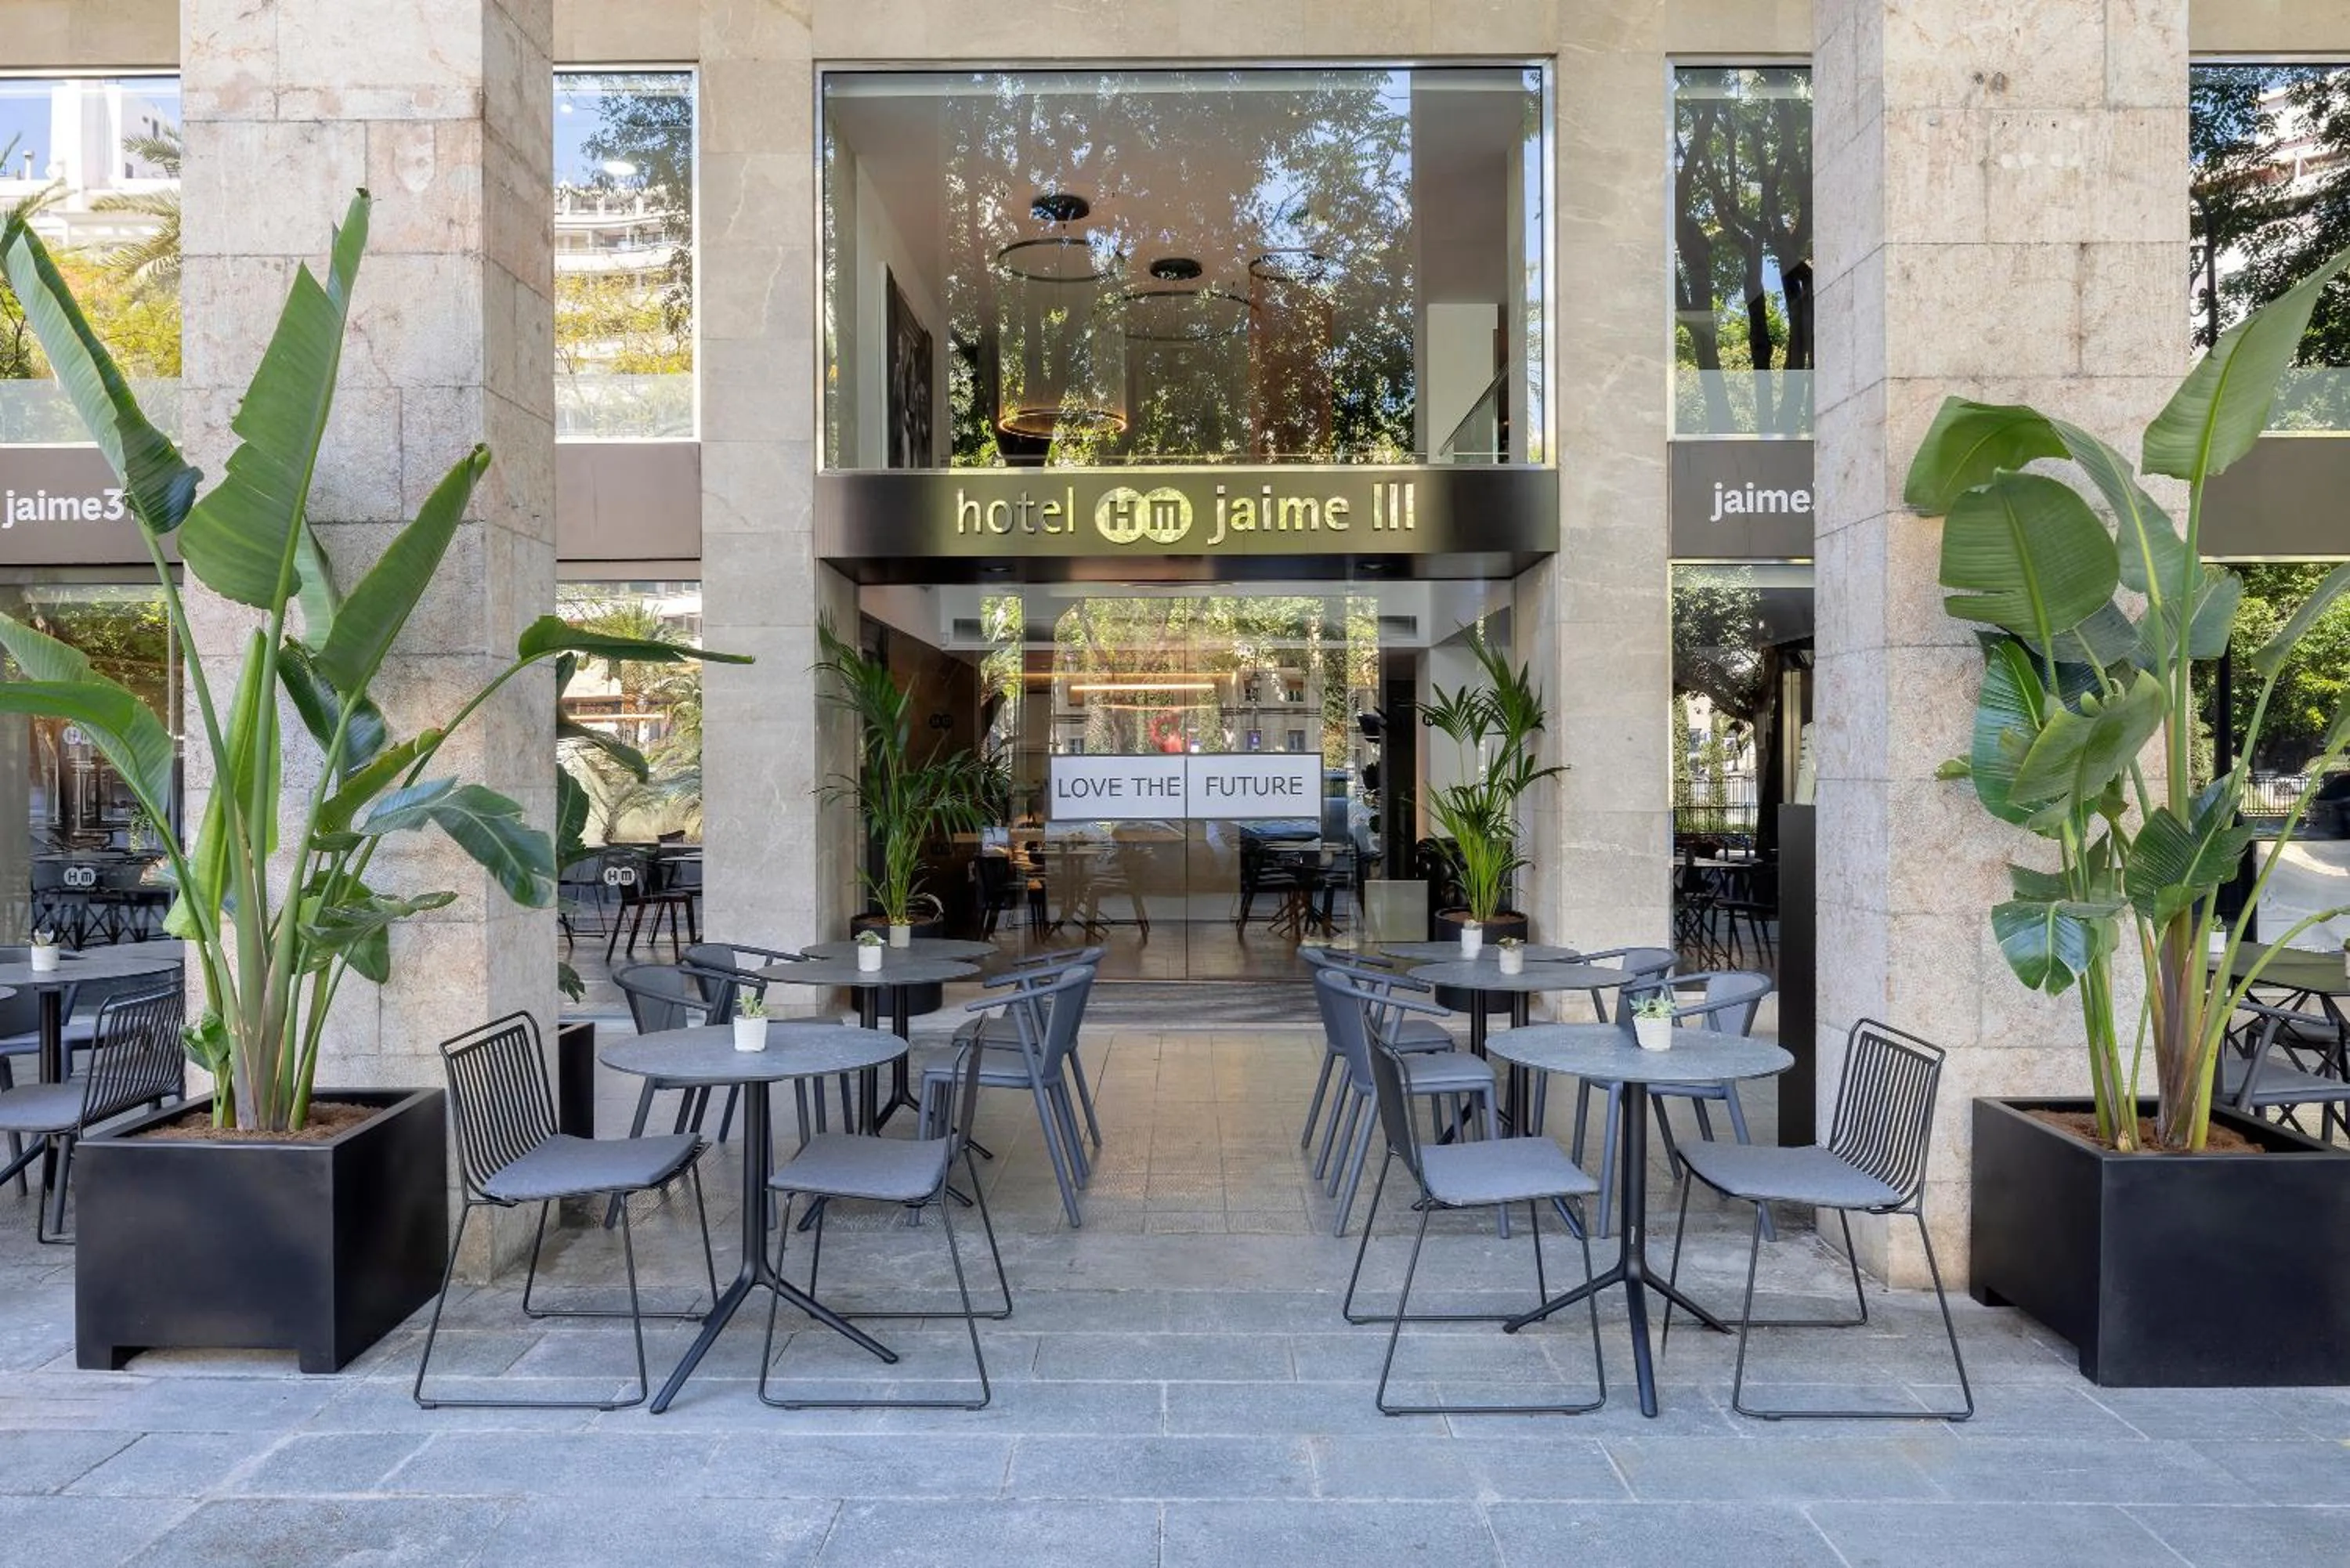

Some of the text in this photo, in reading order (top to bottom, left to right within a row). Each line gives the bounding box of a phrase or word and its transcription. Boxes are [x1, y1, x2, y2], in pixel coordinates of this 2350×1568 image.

[956, 486, 1075, 533] hotel
[1207, 484, 1350, 544] jaime
[1709, 482, 1814, 522] jaime
[1058, 775, 1303, 799] LOVE THE FUTURE
